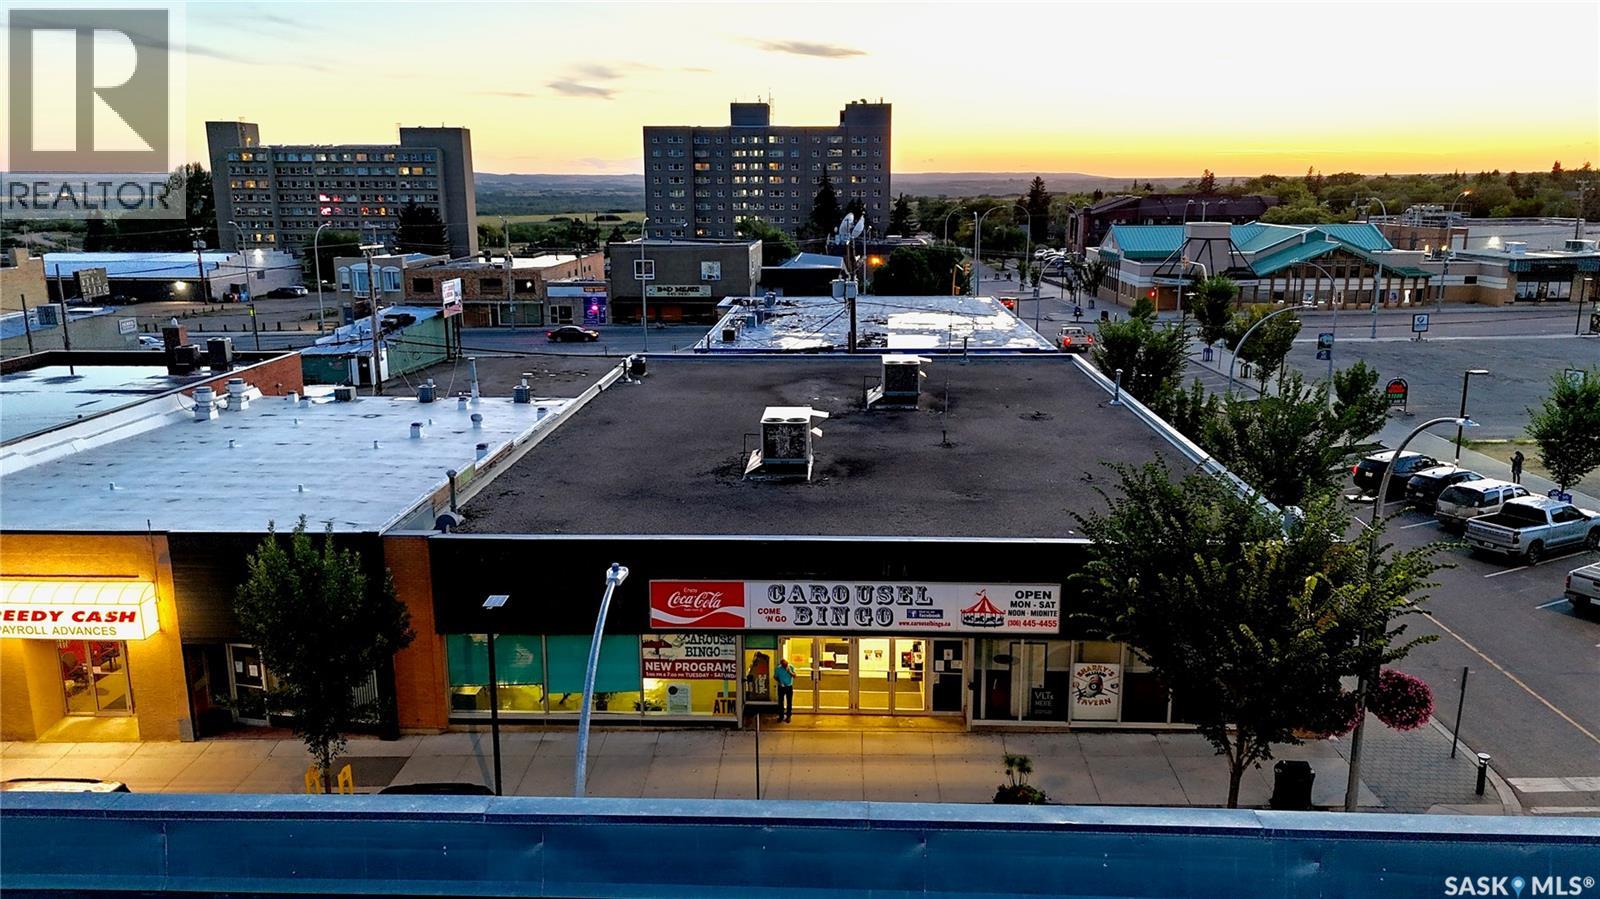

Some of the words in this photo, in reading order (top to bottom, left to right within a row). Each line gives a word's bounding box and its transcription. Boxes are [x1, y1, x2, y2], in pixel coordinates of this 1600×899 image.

[667, 591, 724, 609] Coca-Cola
[767, 584, 934, 605] CAROUSEL
[1014, 590, 1052, 600] OPEN
[1010, 601, 1031, 609] MON
[1038, 601, 1056, 609] SAT
[0, 609, 63, 622] EEDY
[72, 610, 137, 623] CASH
[793, 606, 894, 627] BINGO
[1007, 609, 1026, 617] NOON
[52, 626, 117, 636] ADVANCES
[685, 646, 720, 657] BINGO
[645, 661, 673, 671] NEW
[675, 662, 736, 673] PROGRAMS
[713, 699, 736, 713] ATM
[1076, 697, 1112, 706] TAVERN
